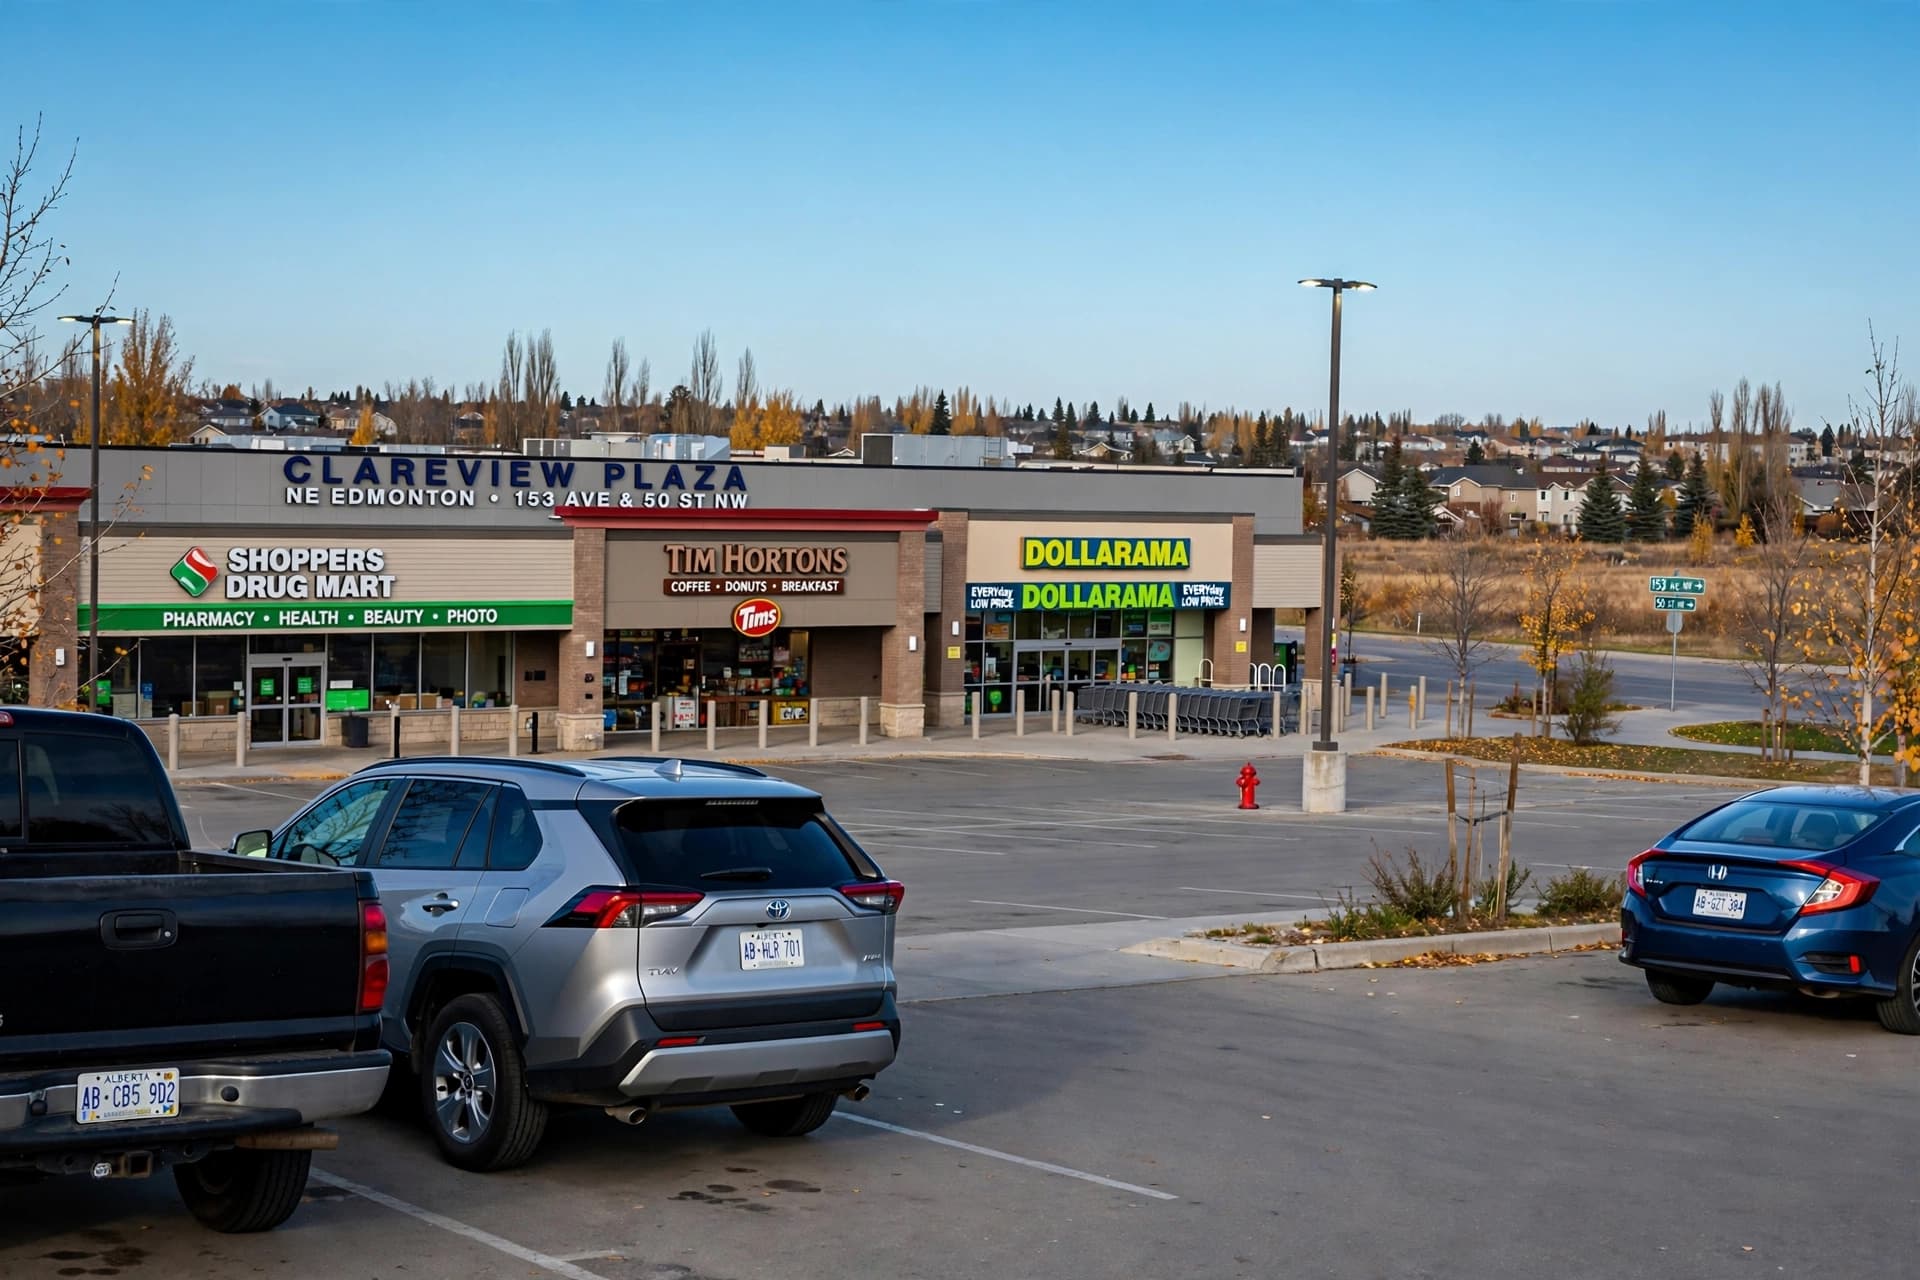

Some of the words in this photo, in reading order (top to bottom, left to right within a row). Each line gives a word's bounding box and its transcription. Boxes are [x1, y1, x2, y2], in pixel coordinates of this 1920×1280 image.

[283, 455, 575, 488] CLAREVIEW
[604, 463, 748, 491] PLAZA
[286, 487, 319, 504] NE
[331, 487, 474, 506] EDMONTON
[515, 490, 555, 507] 153
[565, 491, 610, 508] AVE
[620, 492, 633, 508] &
[644, 492, 670, 508] 50
[680, 493, 706, 508] ST
[715, 494, 748, 509] NW
[227, 547, 385, 573] SHOPPERS
[664, 544, 716, 574] TIM
[723, 543, 848, 574] HORTONS
[1025, 539, 1189, 567] DOLLARAMA
[225, 575, 308, 599] DRUG
[315, 574, 396, 599] MART
[671, 580, 711, 592] COFFEE
[725, 580, 767, 592] DONUTS
[781, 580, 839, 592] BREAKFAST
[1652, 578, 1667, 591] 153
[971, 598, 989, 609] LOW
[1022, 583, 1175, 610] DOLLARAMA
[1181, 596, 1199, 607] LOW
[163, 611, 255, 627] PHARMACY
[279, 610, 339, 626] HEALTH
[363, 609, 424, 625] BEAUTY
[447, 608, 498, 623] PHOTO
[739, 605, 777, 631] Tims
[784, 939, 800, 957] 701
[104, 1073, 150, 1084] ALBERTA
[149, 1082, 175, 1104] 9D2
